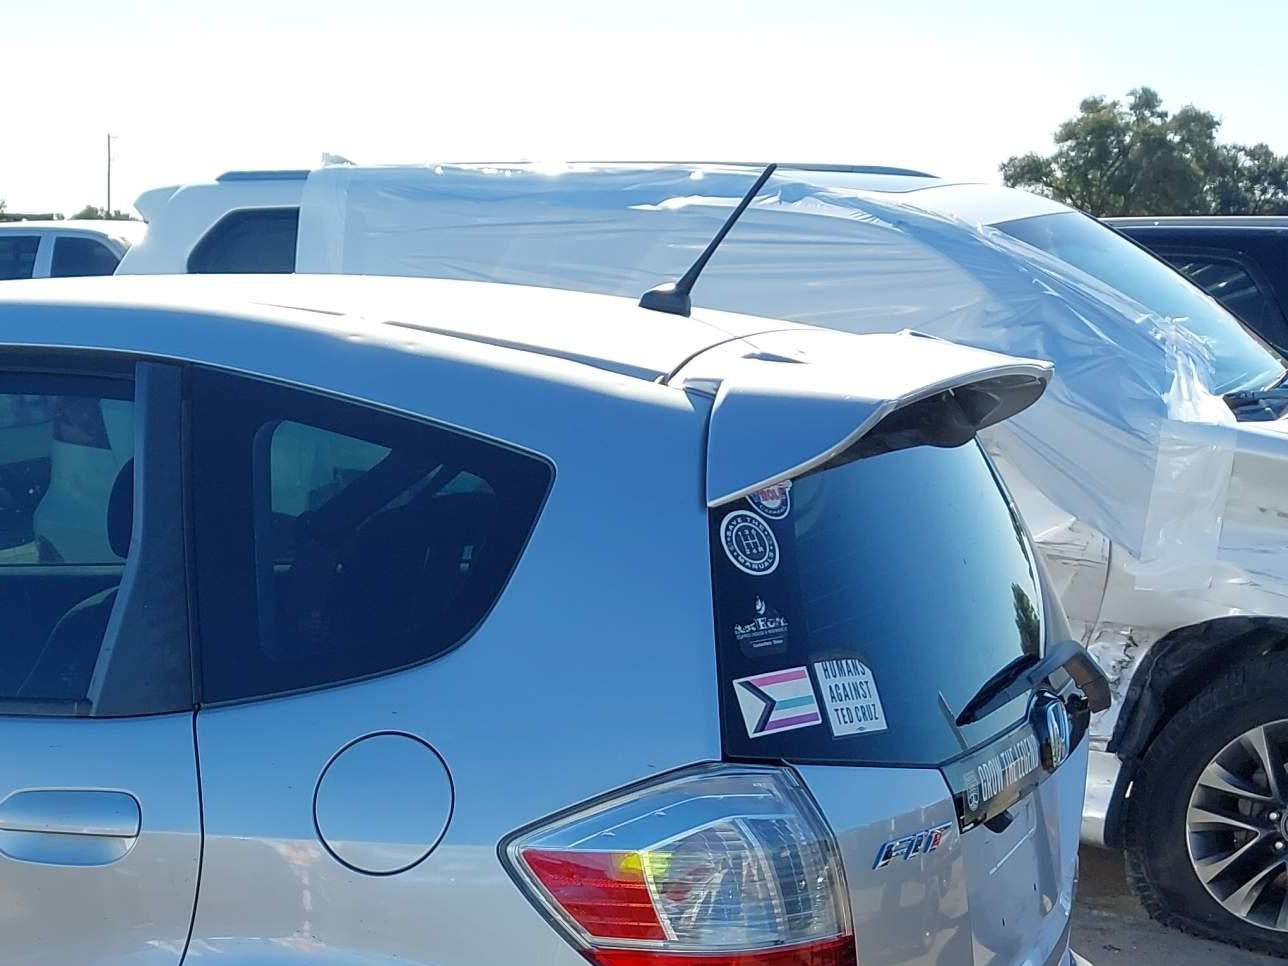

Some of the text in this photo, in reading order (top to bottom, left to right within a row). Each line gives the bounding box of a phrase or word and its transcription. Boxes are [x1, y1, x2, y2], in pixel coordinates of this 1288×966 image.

[821, 659, 866, 680] HUMANS
[828, 681, 872, 703] AGAINST
[833, 704, 879, 725] TED CRUZ
[977, 755, 1004, 802] GROW
[1000, 748, 1018, 787] THE
